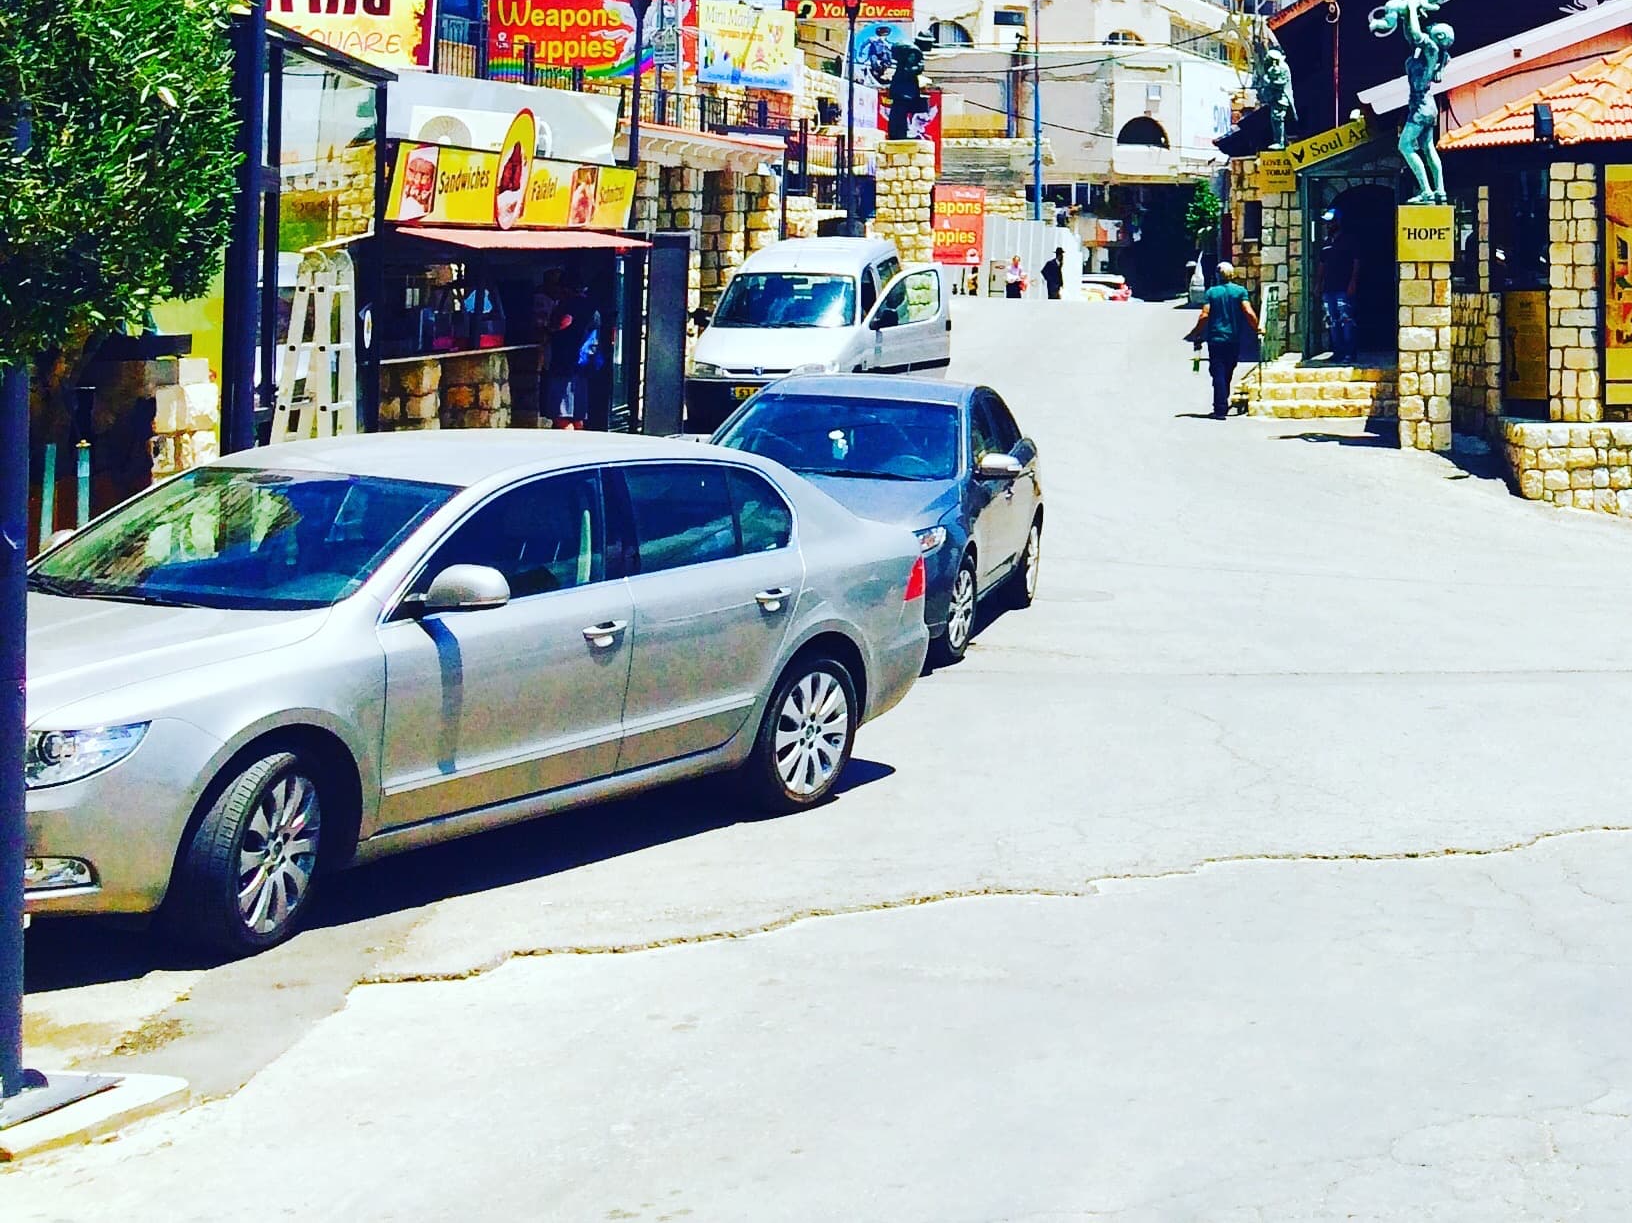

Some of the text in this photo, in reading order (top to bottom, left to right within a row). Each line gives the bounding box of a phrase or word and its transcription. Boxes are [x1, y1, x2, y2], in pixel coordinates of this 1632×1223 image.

[498, 0, 622, 31] Weapons
[822, 2, 910, 18] YoTov.com
[290, 28, 400, 54] QUARE
[513, 34, 617, 65] Puppies
[1309, 128, 1368, 157] Soul Ar
[438, 166, 491, 195] Sandwiches
[934, 201, 983, 217] eapons
[932, 228, 977, 247] ppies
[1402, 227, 1451, 241] "HOPE"
